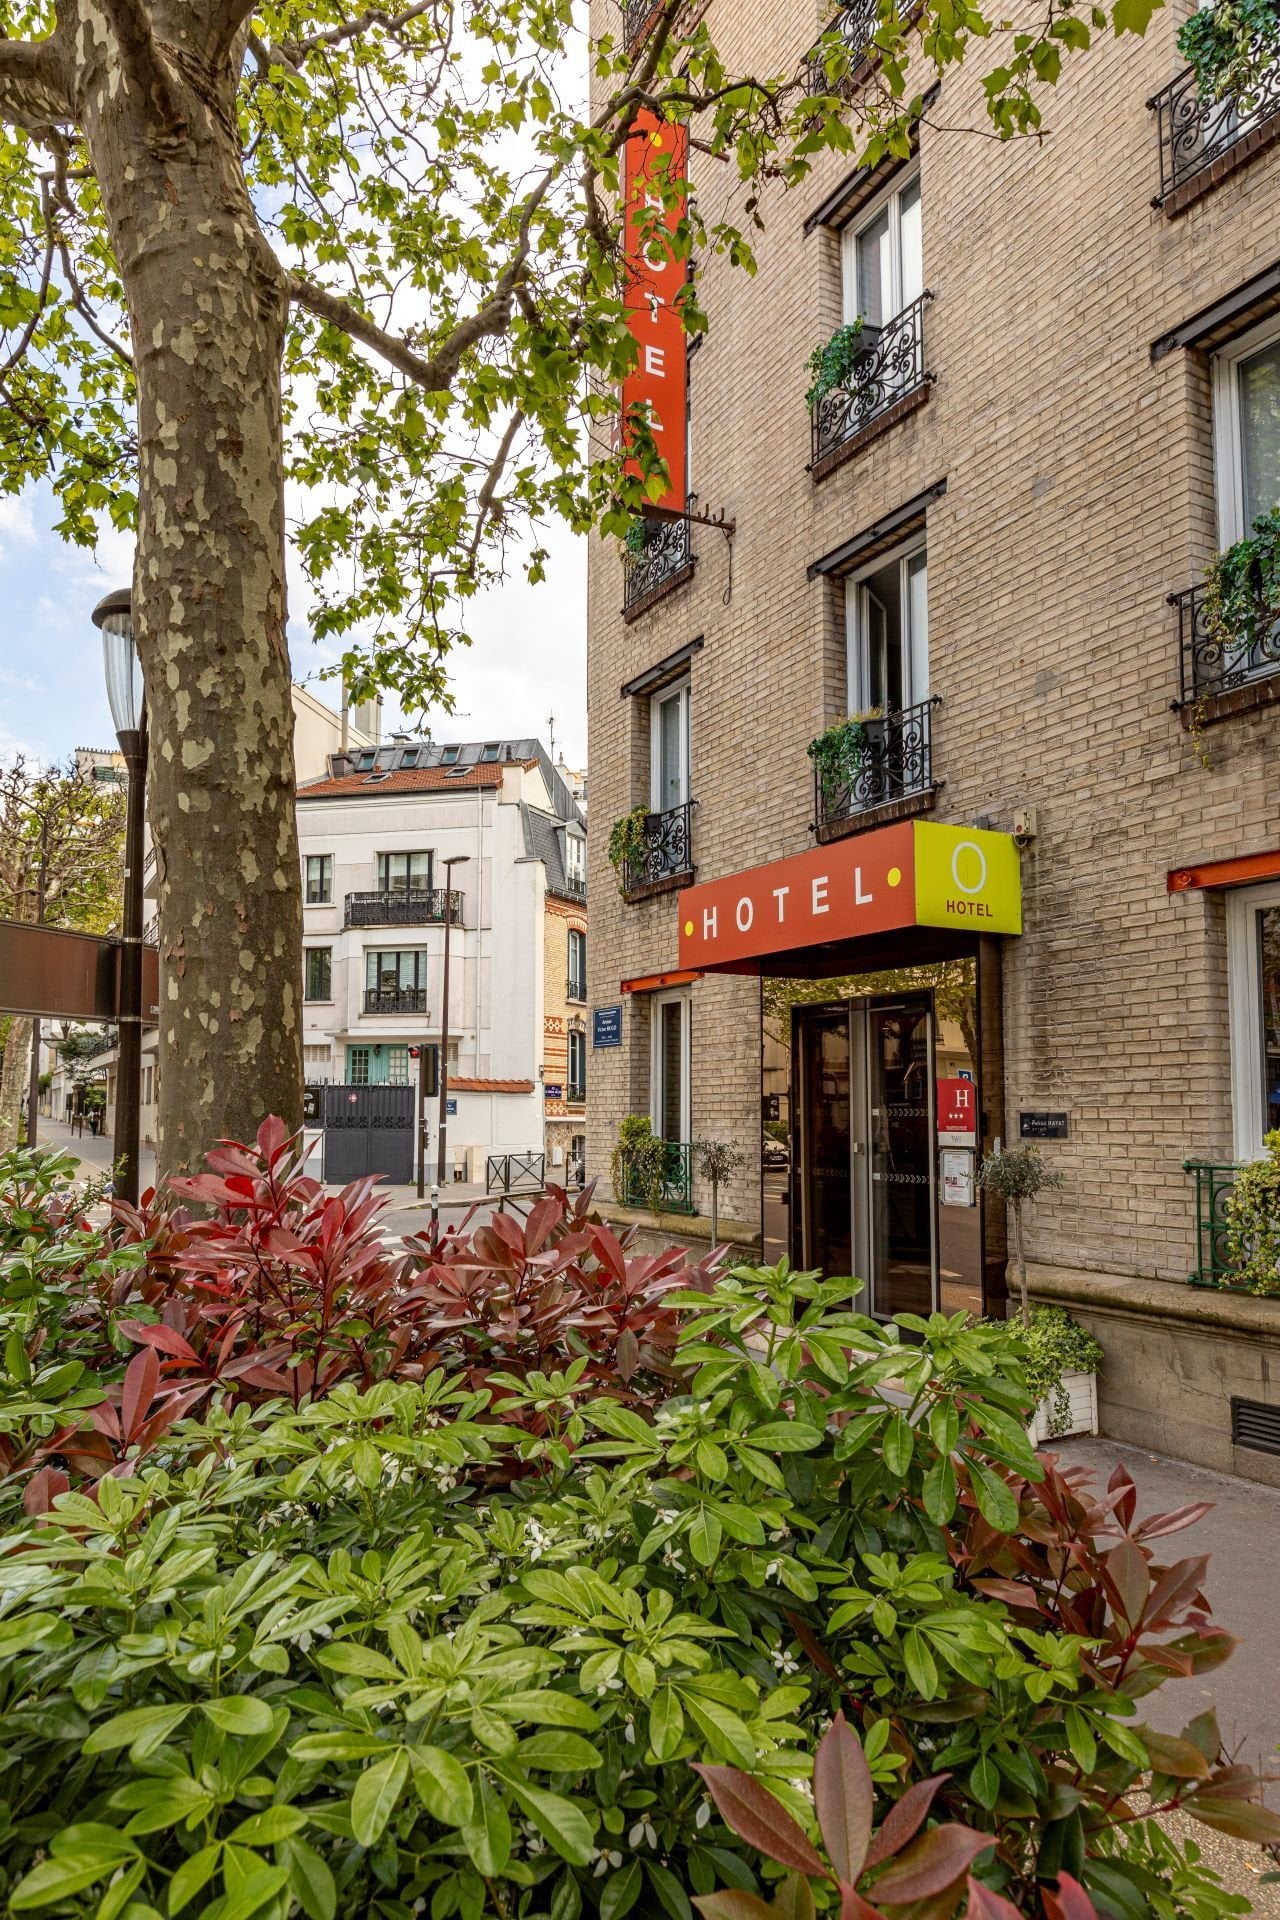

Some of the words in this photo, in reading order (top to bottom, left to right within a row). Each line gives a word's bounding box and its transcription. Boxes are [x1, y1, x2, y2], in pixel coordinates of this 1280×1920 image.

[703, 867, 873, 940] HOTEL
[946, 900, 994, 918] HOTEL
[955, 1089, 969, 1107] H
